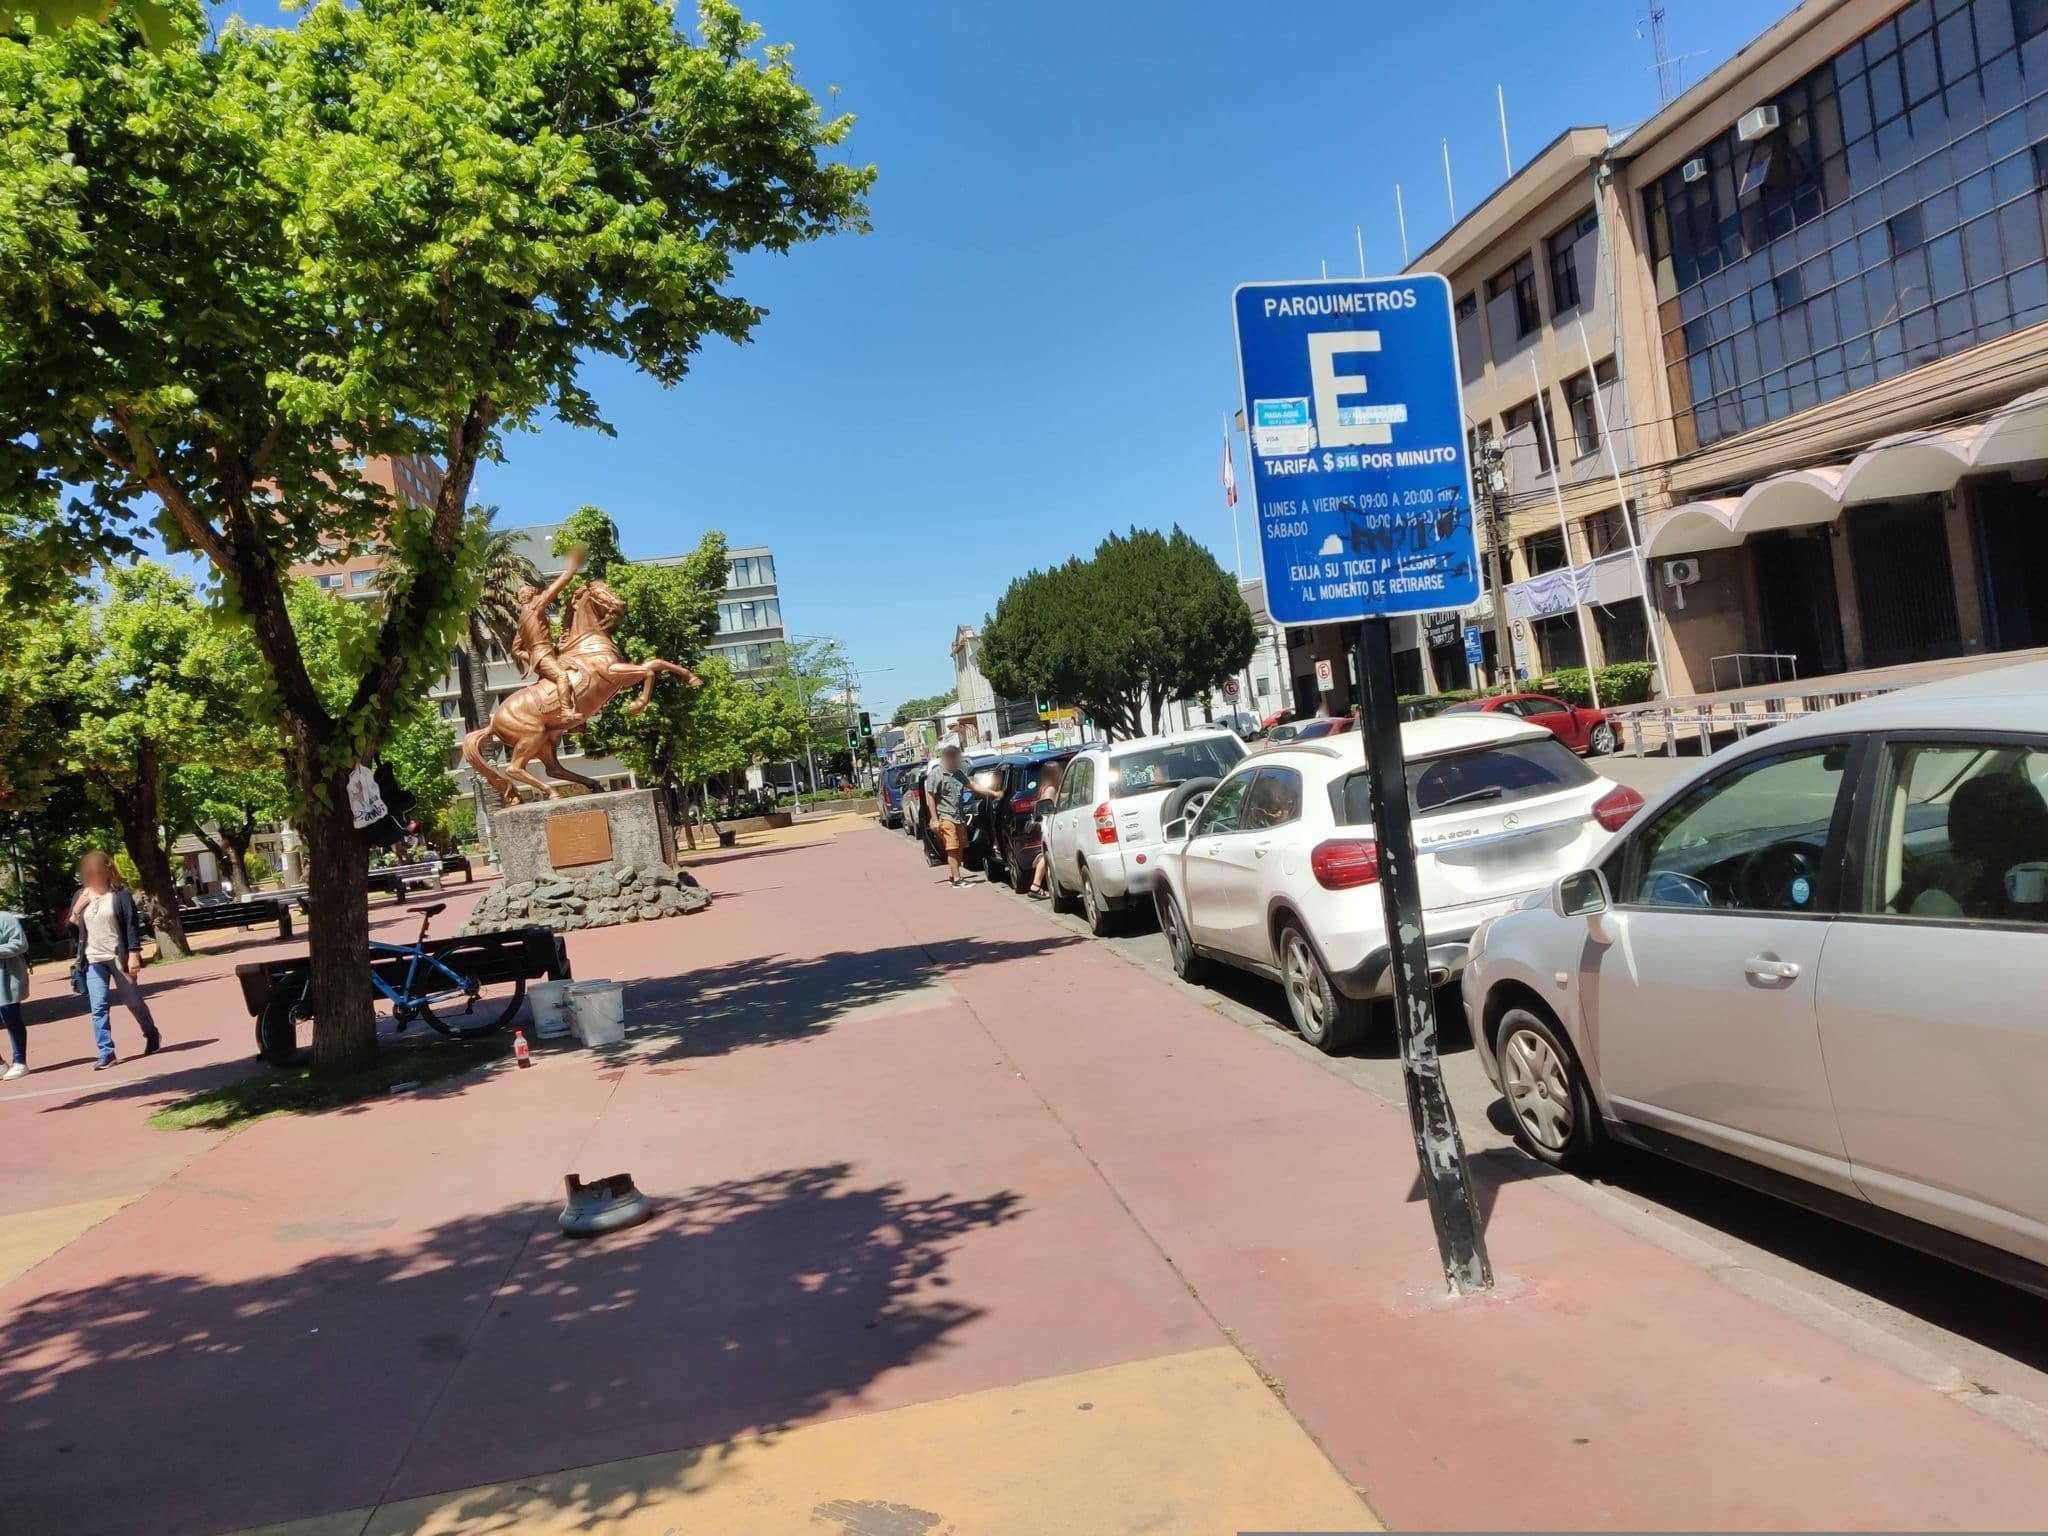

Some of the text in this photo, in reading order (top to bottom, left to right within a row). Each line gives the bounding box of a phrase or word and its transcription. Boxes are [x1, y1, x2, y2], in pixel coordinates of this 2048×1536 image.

[1264, 288, 1417, 317] PARQUIMETROS
[1307, 330, 1393, 448] E
[1264, 458, 1319, 475] TARIFA
[1362, 453, 1393, 469] POR
[1396, 446, 1457, 467] MINUTO
[1263, 501, 1297, 518] LUNES
[1301, 499, 1310, 515] A
[1312, 495, 1356, 513] VIERNES
[1360, 491, 1388, 509] 09:00
[1392, 491, 1401, 507] A
[1403, 488, 1434, 505] 20:00
[1267, 519, 1309, 539] SÁBADO
[1395, 511, 1404, 527] A
[1290, 563, 1322, 581] EXIJA
[1325, 560, 1339, 578] SU
[1343, 558, 1377, 577] TICKET
[1302, 574, 1445, 602] AL MOMENTO DE RETIRARSE
